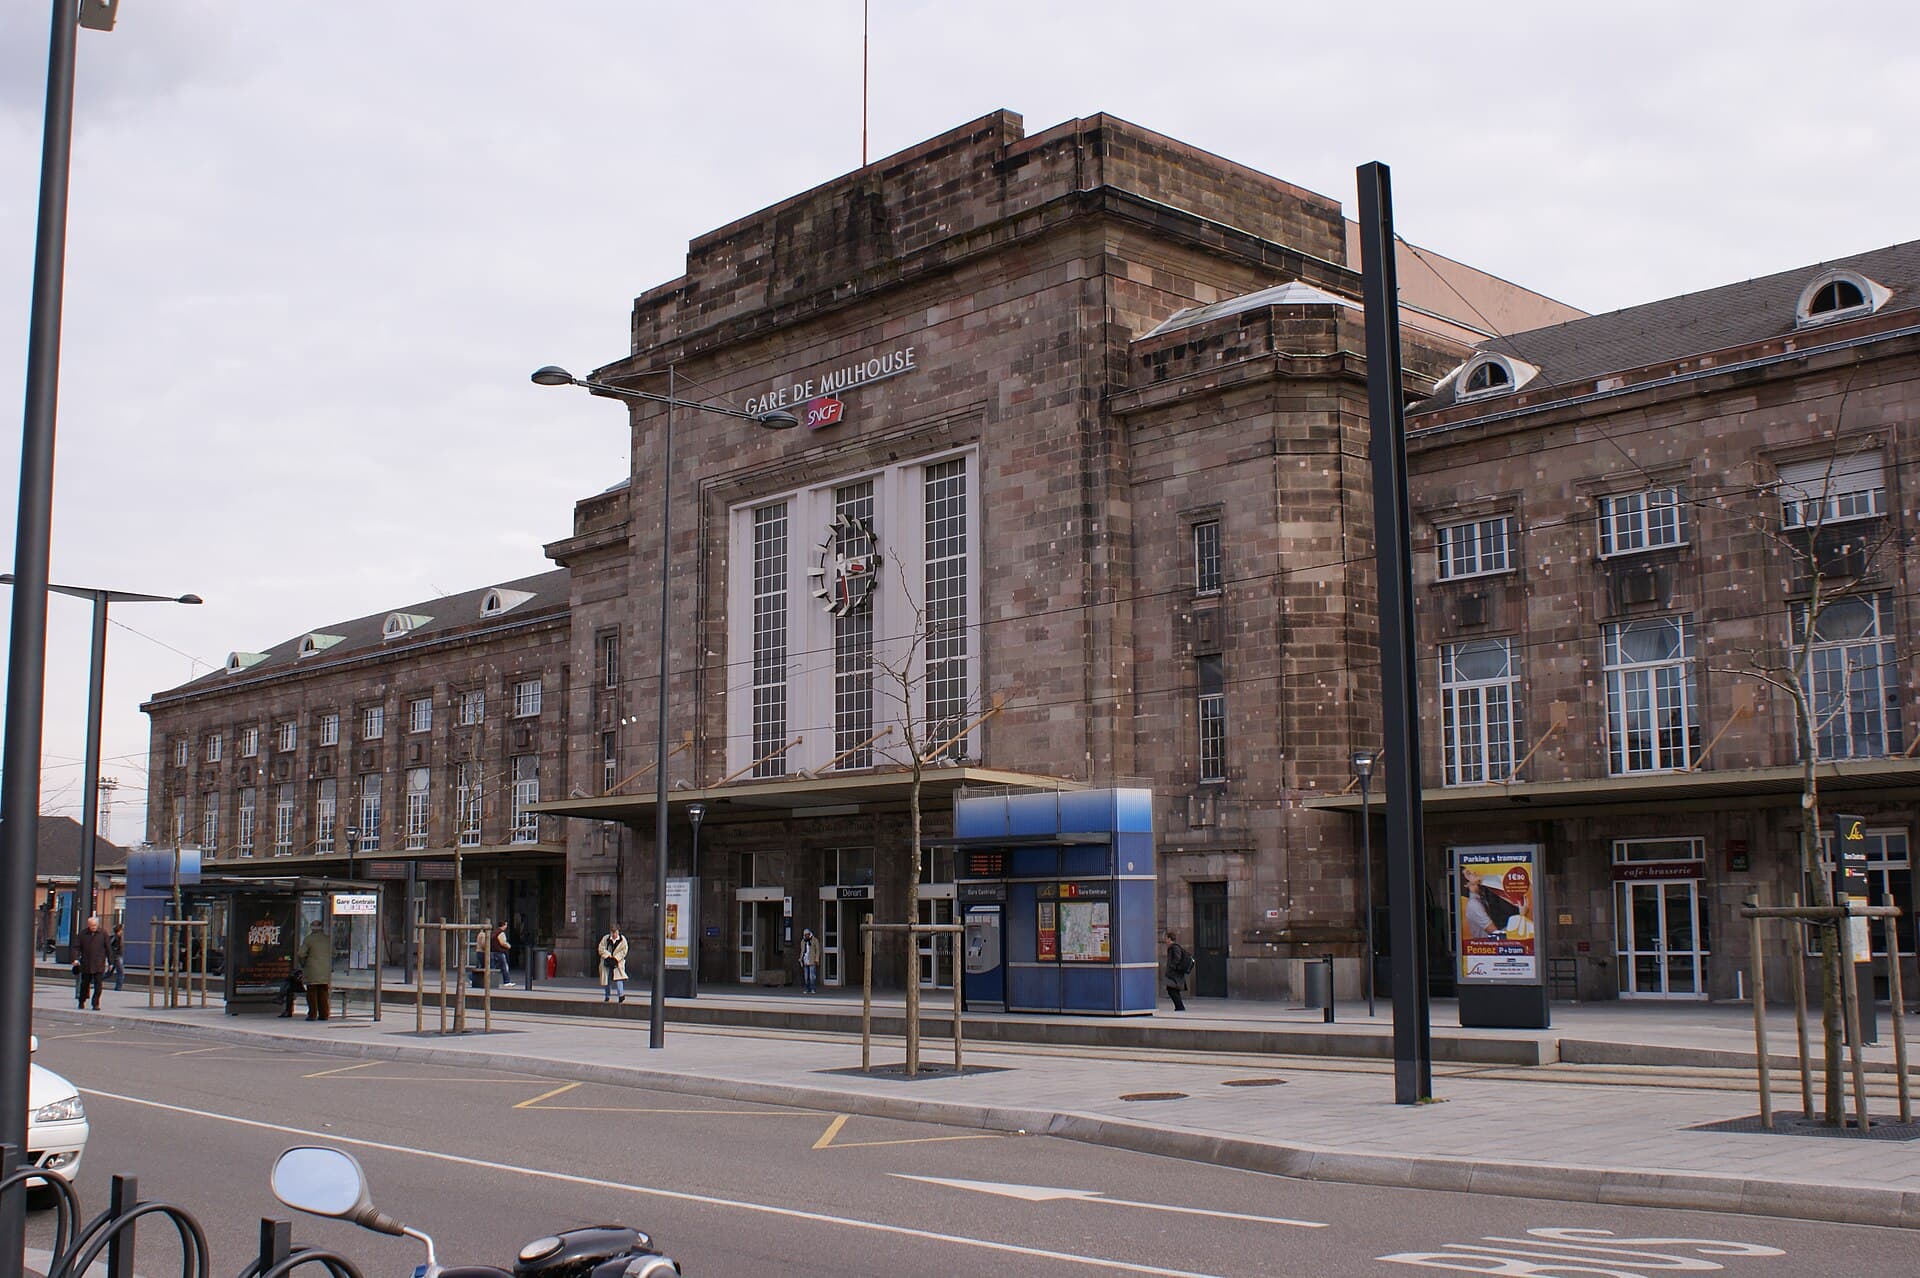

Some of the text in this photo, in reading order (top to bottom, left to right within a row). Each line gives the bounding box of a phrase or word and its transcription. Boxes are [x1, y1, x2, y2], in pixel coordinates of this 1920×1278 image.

[746, 347, 915, 415] GARE DE MULHOUSE
[808, 404, 838, 425] SNCF
[1467, 945, 1497, 954] Pensez
[1374, 1227, 1786, 1278] BUS
